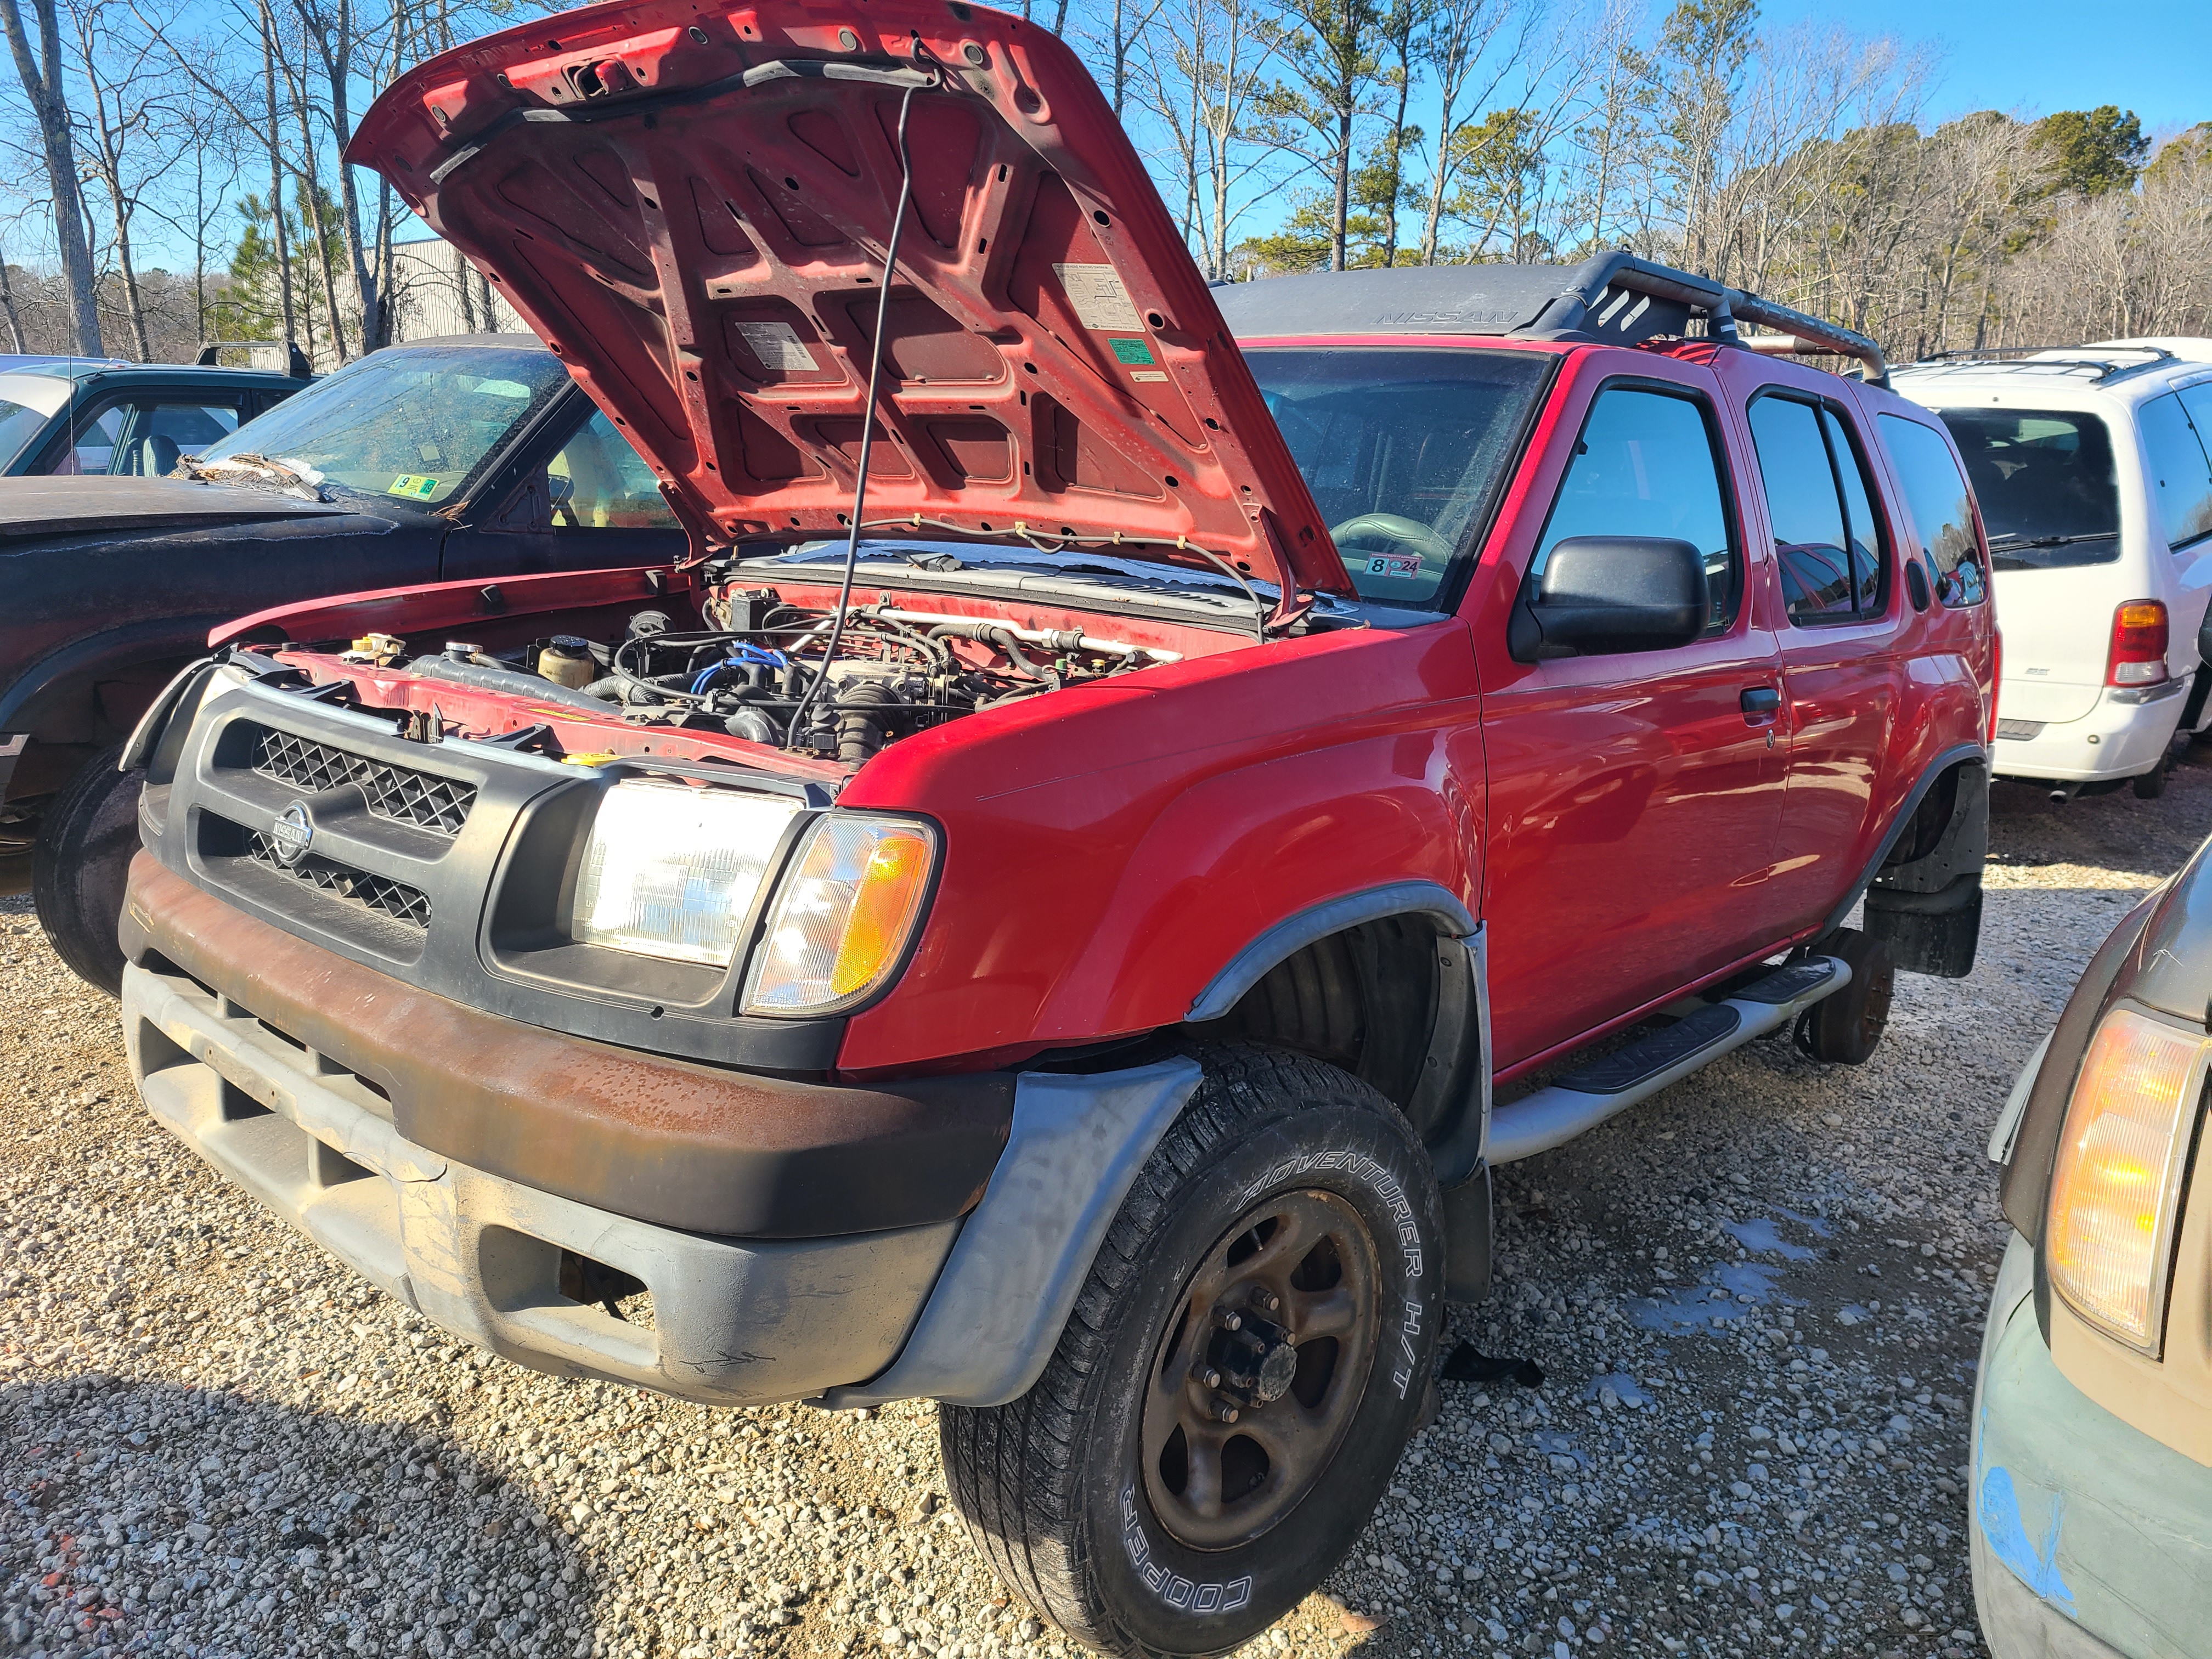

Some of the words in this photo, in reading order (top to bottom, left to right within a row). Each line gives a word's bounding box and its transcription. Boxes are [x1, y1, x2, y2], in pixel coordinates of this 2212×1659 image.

[1370, 311, 1519, 325] NISSAN
[399, 477, 410, 488] 9
[1372, 559, 1385, 572] 8
[1401, 561, 1418, 572] 24
[273, 822, 303, 844] NISSAN
[585, 900, 594, 908] LH
[1234, 1151, 1423, 1278] ADVENTURER
[1392, 1301, 1423, 1400] H/T
[1121, 1483, 1252, 1612] COOPER
